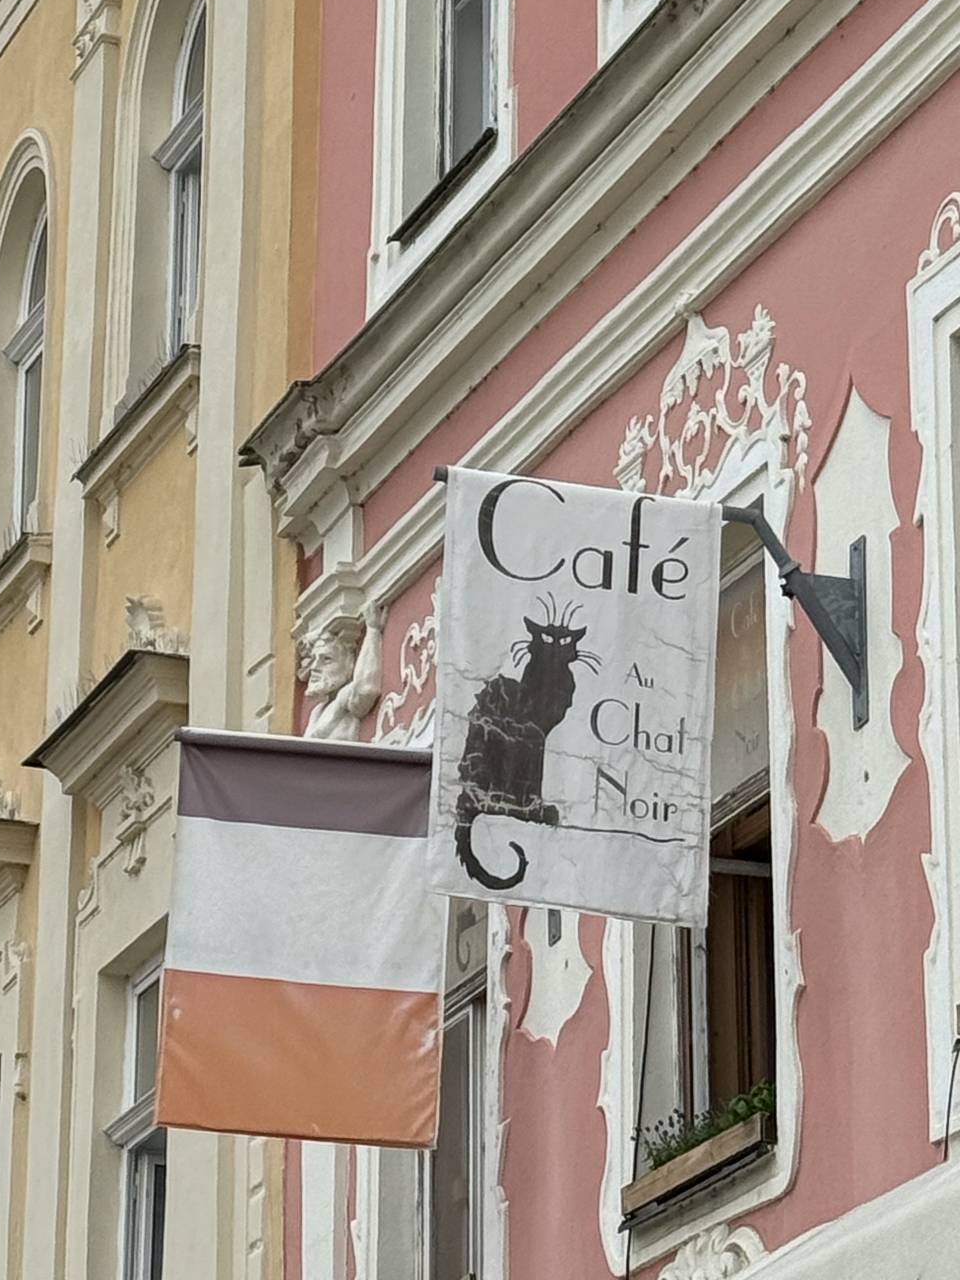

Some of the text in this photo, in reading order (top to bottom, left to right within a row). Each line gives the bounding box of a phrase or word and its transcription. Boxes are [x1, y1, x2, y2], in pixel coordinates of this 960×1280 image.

[477, 479, 690, 600] Café
[624, 663, 654, 689] Au
[590, 698, 686, 756] Chat
[595, 767, 678, 823] Noir
